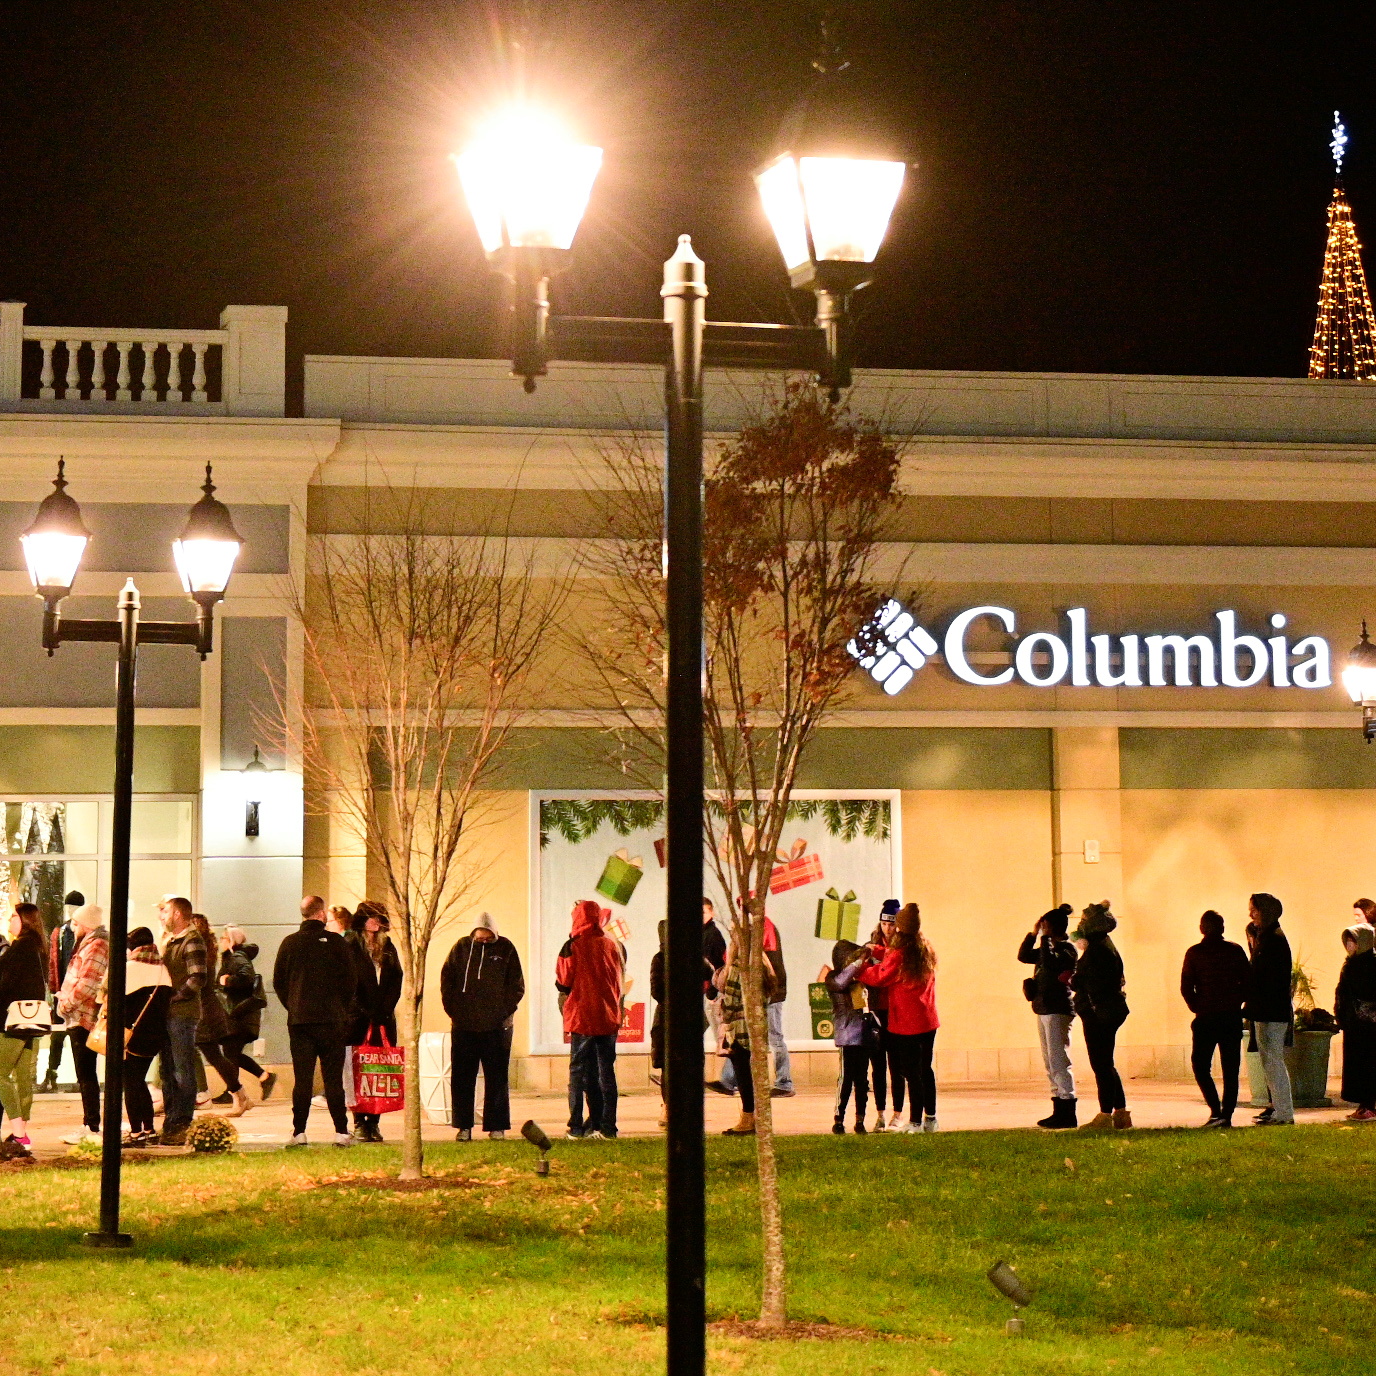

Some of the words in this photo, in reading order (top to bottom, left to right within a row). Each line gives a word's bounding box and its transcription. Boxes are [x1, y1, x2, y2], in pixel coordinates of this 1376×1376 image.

[944, 605, 1332, 688] Columbia
[359, 1053, 379, 1064] DEAR
[360, 1075, 399, 1097] ALL
